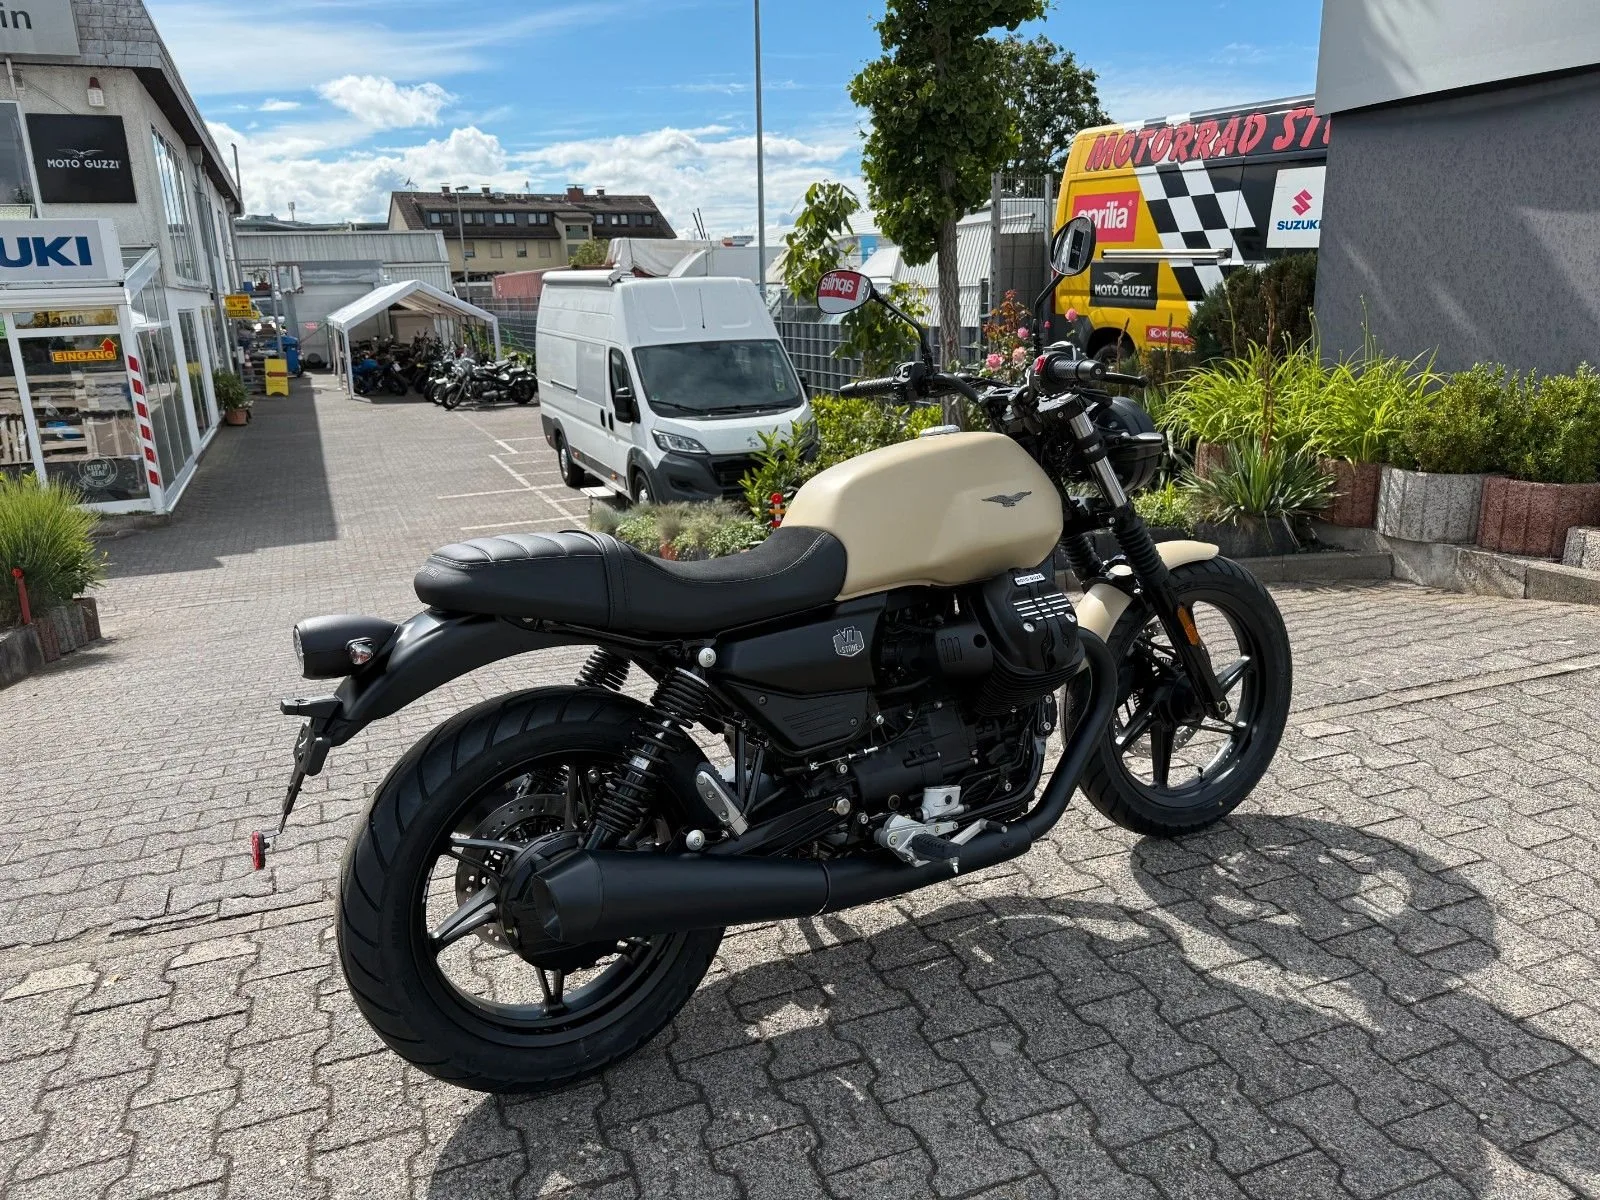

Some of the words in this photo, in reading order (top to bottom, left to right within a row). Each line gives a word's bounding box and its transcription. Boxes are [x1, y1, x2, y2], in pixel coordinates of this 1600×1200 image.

[1085, 112, 1267, 171] MOTORRAD
[47, 159, 80, 168] MOTO
[84, 160, 119, 169] GUZZI
[0, 236, 92, 267] UKI
[1094, 284, 1119, 296] MOTO
[1121, 285, 1149, 297] GUZZI
[54, 350, 114, 361] EINGANG
[836, 626, 855, 642] V7
